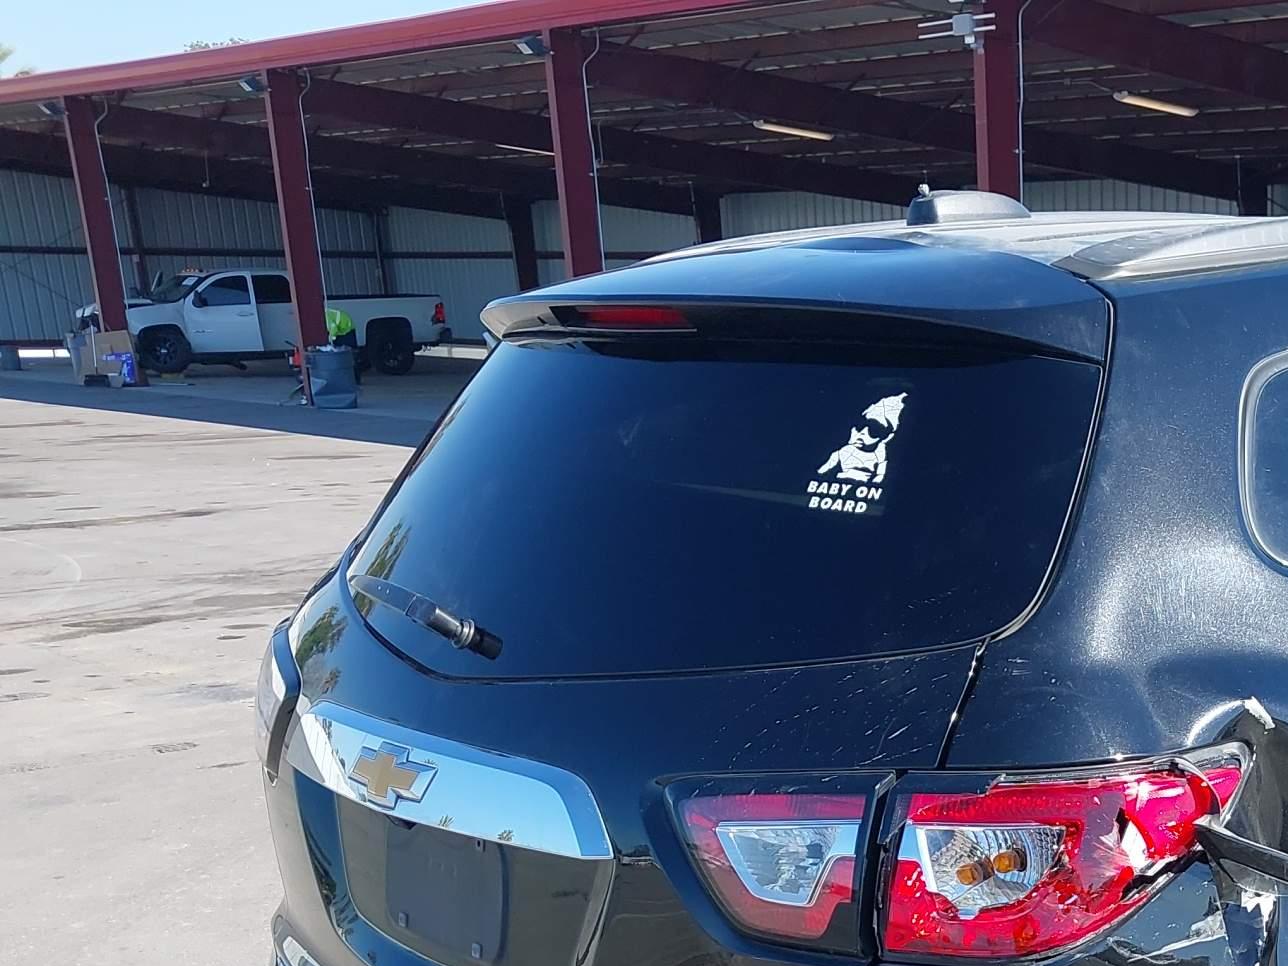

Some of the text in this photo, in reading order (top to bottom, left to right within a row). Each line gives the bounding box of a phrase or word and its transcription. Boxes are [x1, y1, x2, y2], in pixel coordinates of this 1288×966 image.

[807, 480, 883, 500] BABY ON
[808, 496, 867, 513] BOARD
